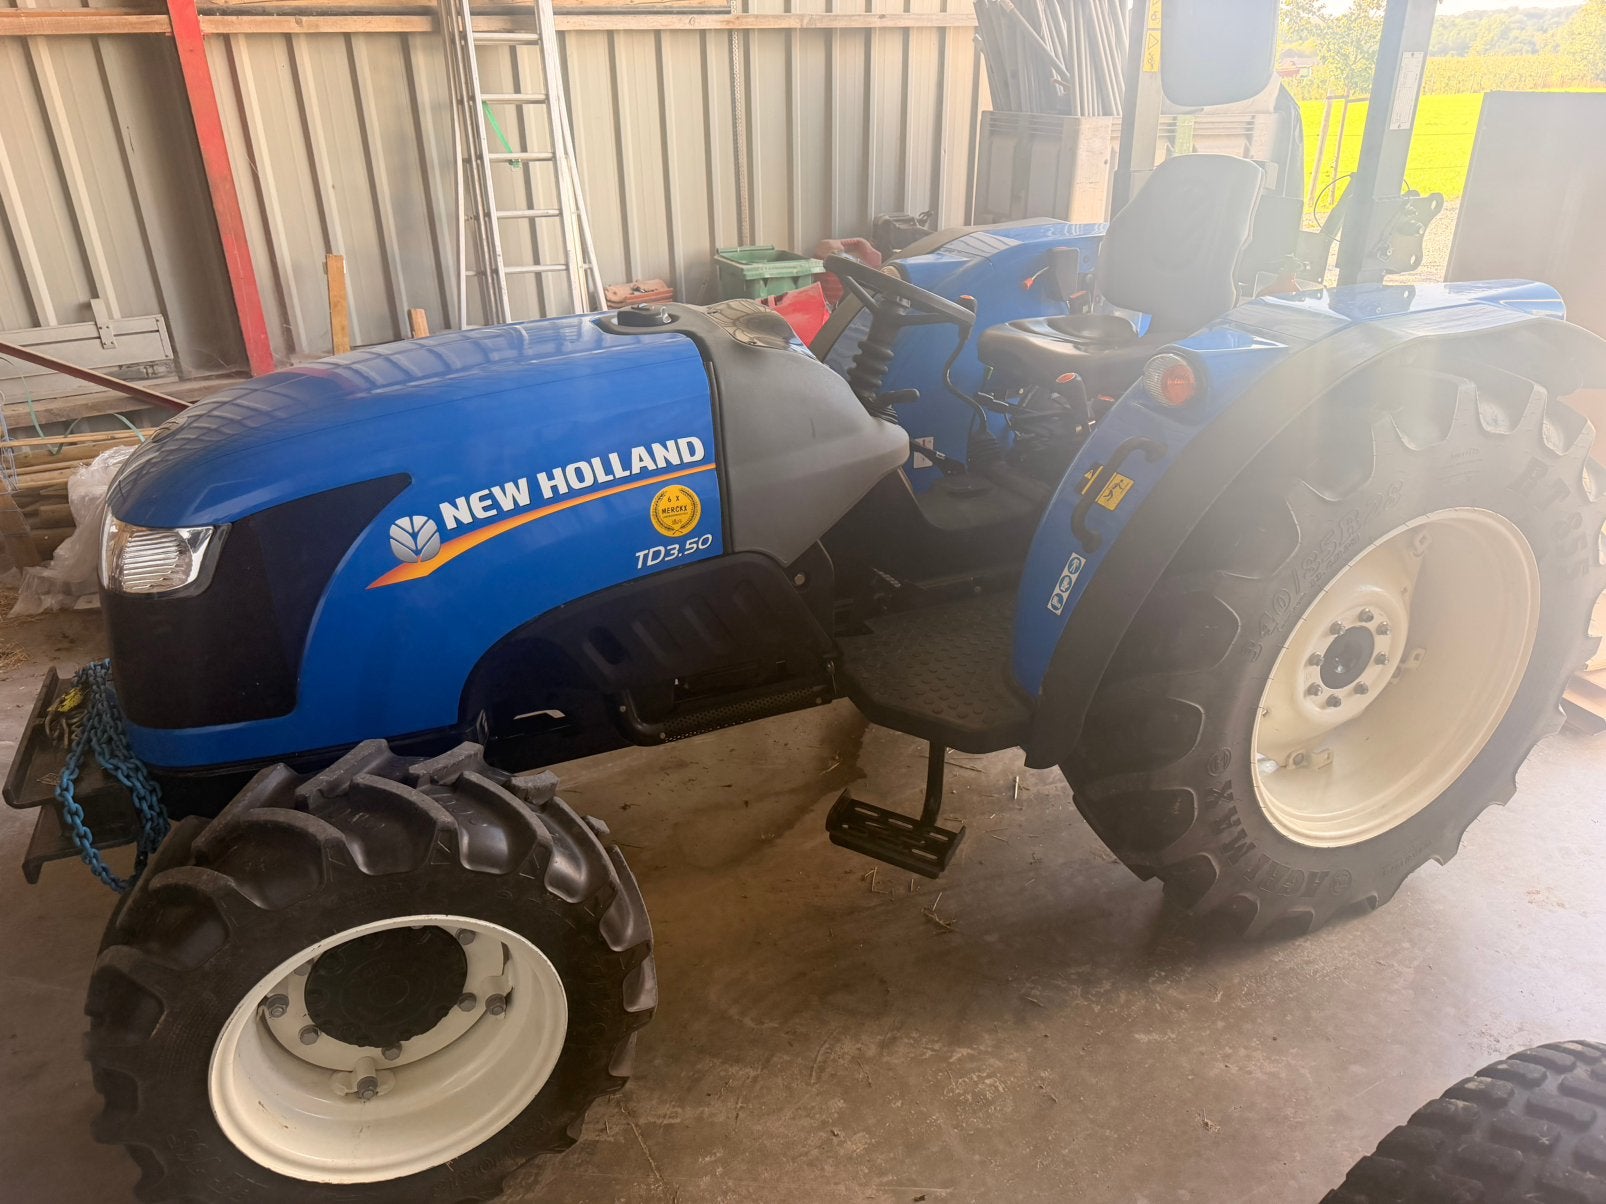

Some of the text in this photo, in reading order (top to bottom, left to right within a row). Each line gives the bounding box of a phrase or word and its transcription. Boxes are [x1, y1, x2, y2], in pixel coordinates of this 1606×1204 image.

[439, 436, 705, 530] NEW HOLLAND
[661, 504, 688, 515] MERCKX
[635, 533, 713, 569] TD3.50
[1206, 779, 1331, 898] AGRIMAX
